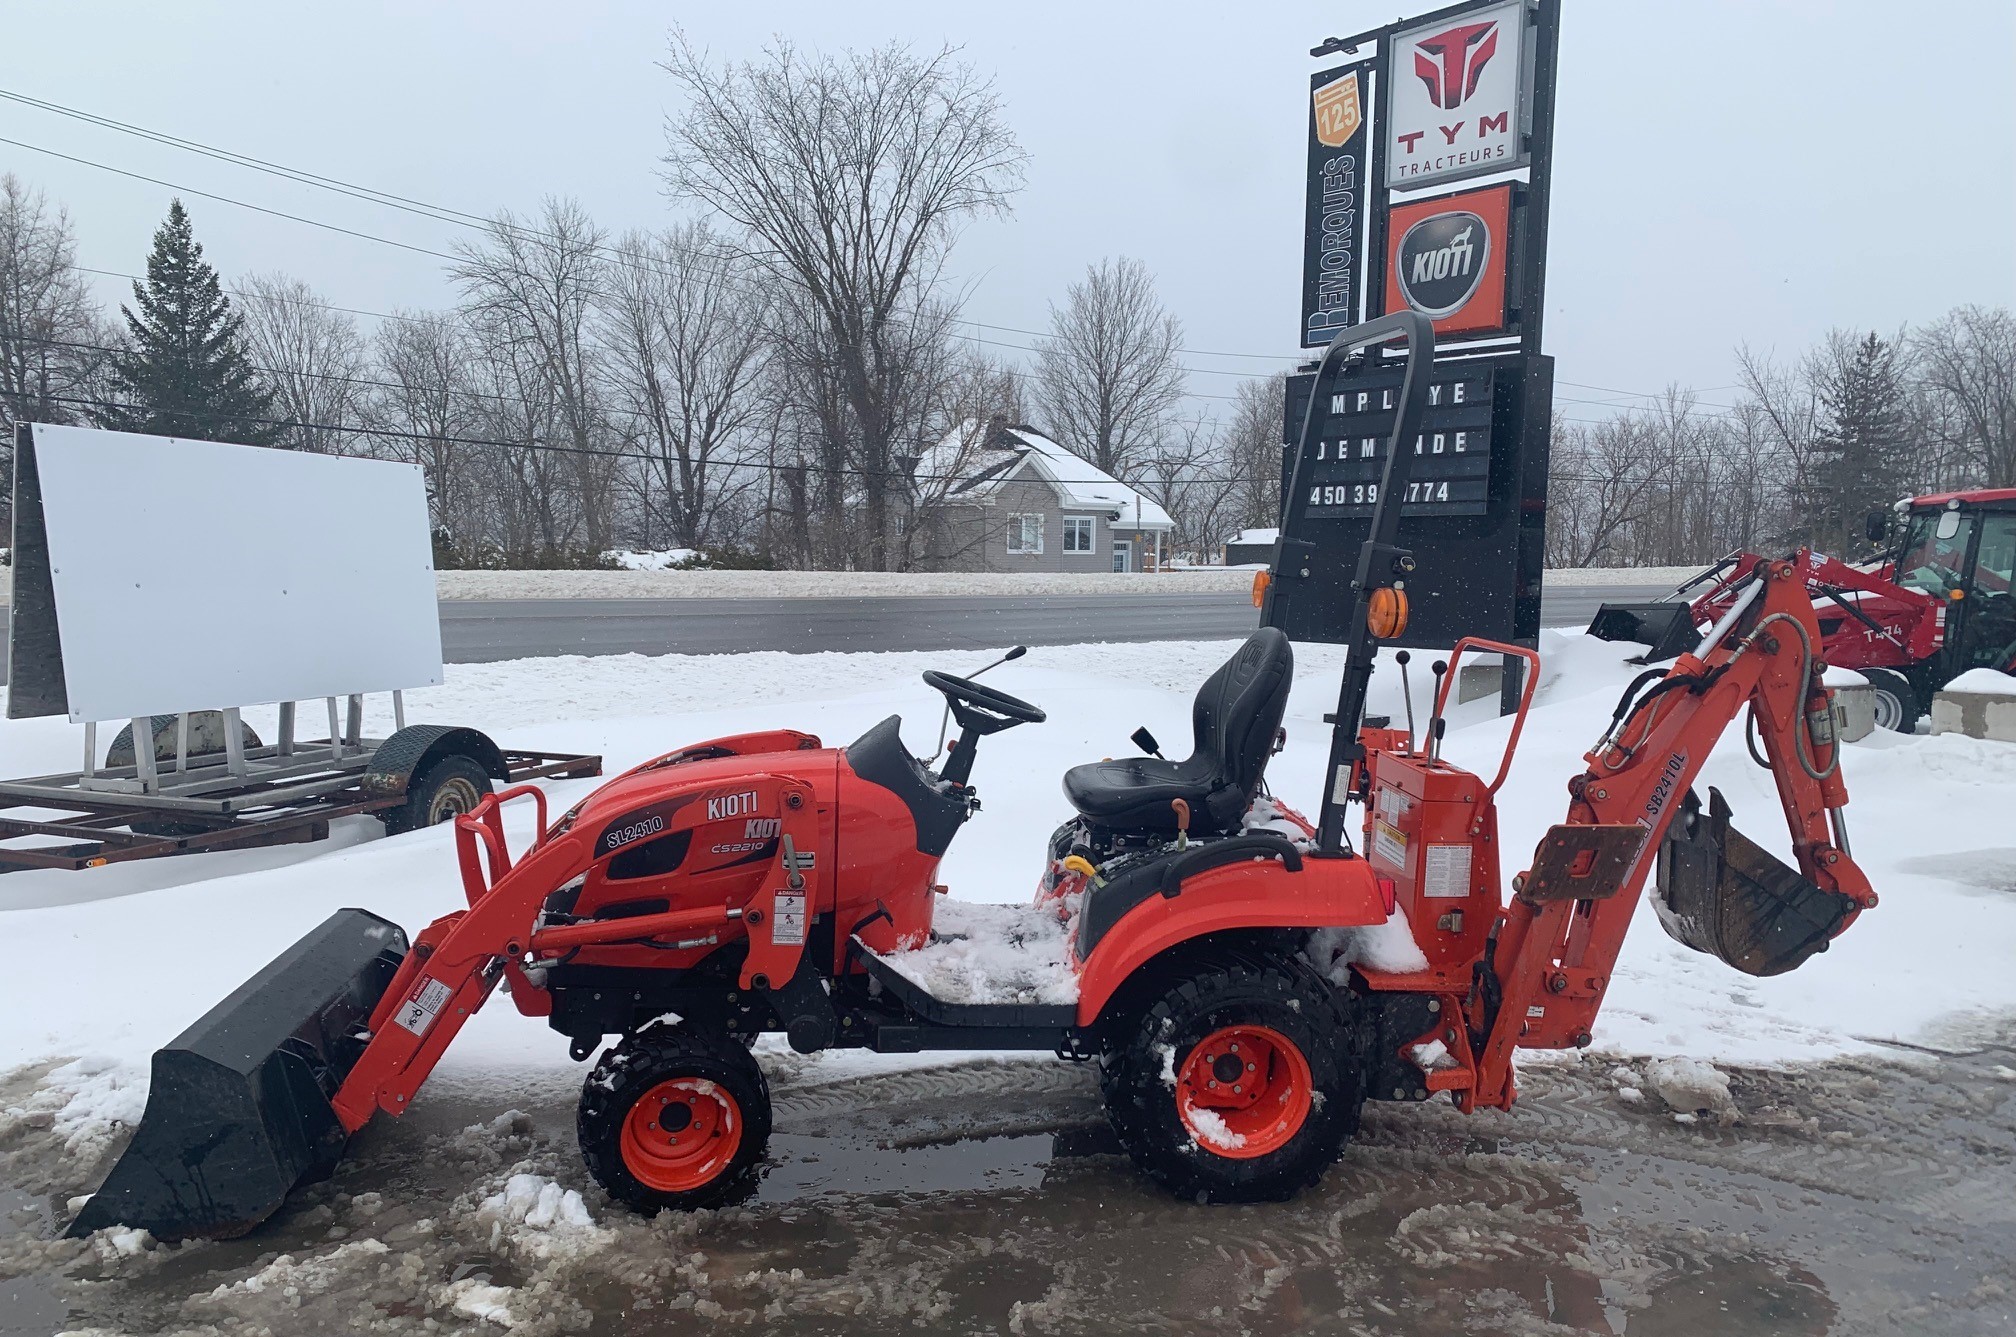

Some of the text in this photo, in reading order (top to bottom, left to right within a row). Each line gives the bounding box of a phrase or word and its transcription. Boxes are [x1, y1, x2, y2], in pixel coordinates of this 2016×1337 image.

[1321, 97, 1356, 136] 125
[1397, 110, 1508, 154] TYM
[1399, 144, 1505, 177] TRACTEURS
[1307, 154, 1356, 345] REMORQUES
[1411, 243, 1474, 285] KIOTI
[1331, 382, 1464, 415] MPLYE
[1310, 486, 1346, 506] 450
[1402, 482, 1449, 503] 774
[1645, 752, 1686, 816] SB2410L
[707, 790, 758, 820] KIOTI
[606, 815, 664, 849] SL2410
[711, 842, 765, 854] CS2210
